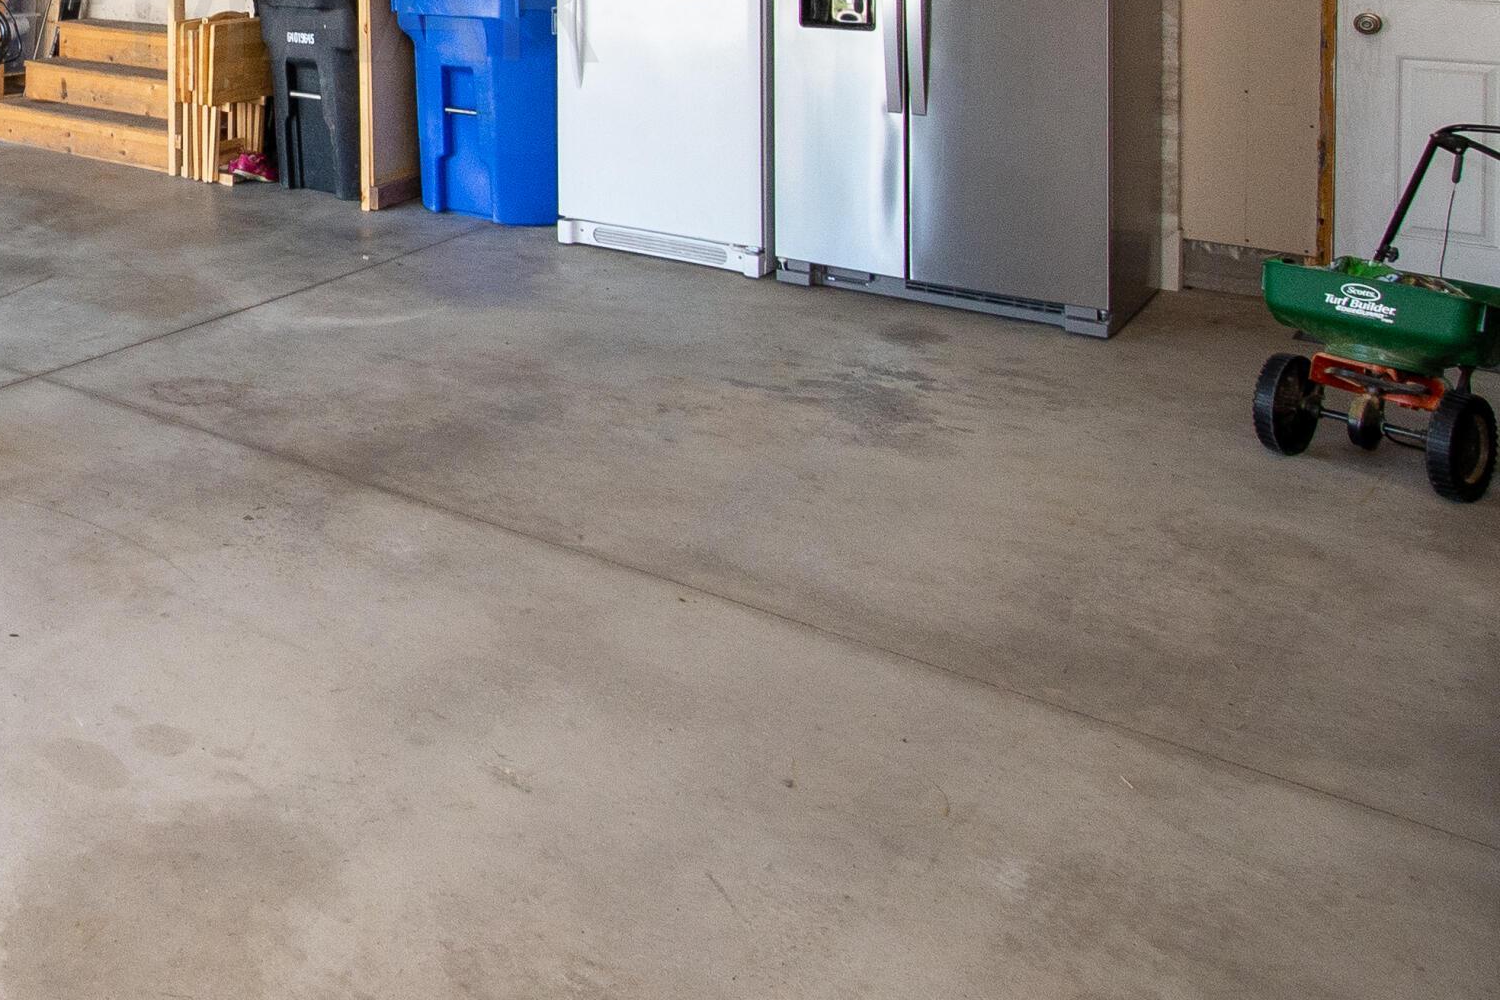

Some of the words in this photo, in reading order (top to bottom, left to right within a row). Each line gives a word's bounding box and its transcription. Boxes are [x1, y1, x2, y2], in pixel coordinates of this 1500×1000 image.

[1346, 286, 1376, 298] Scotts
[1324, 293, 1349, 305] Turf
[1349, 298, 1396, 315] Builder
